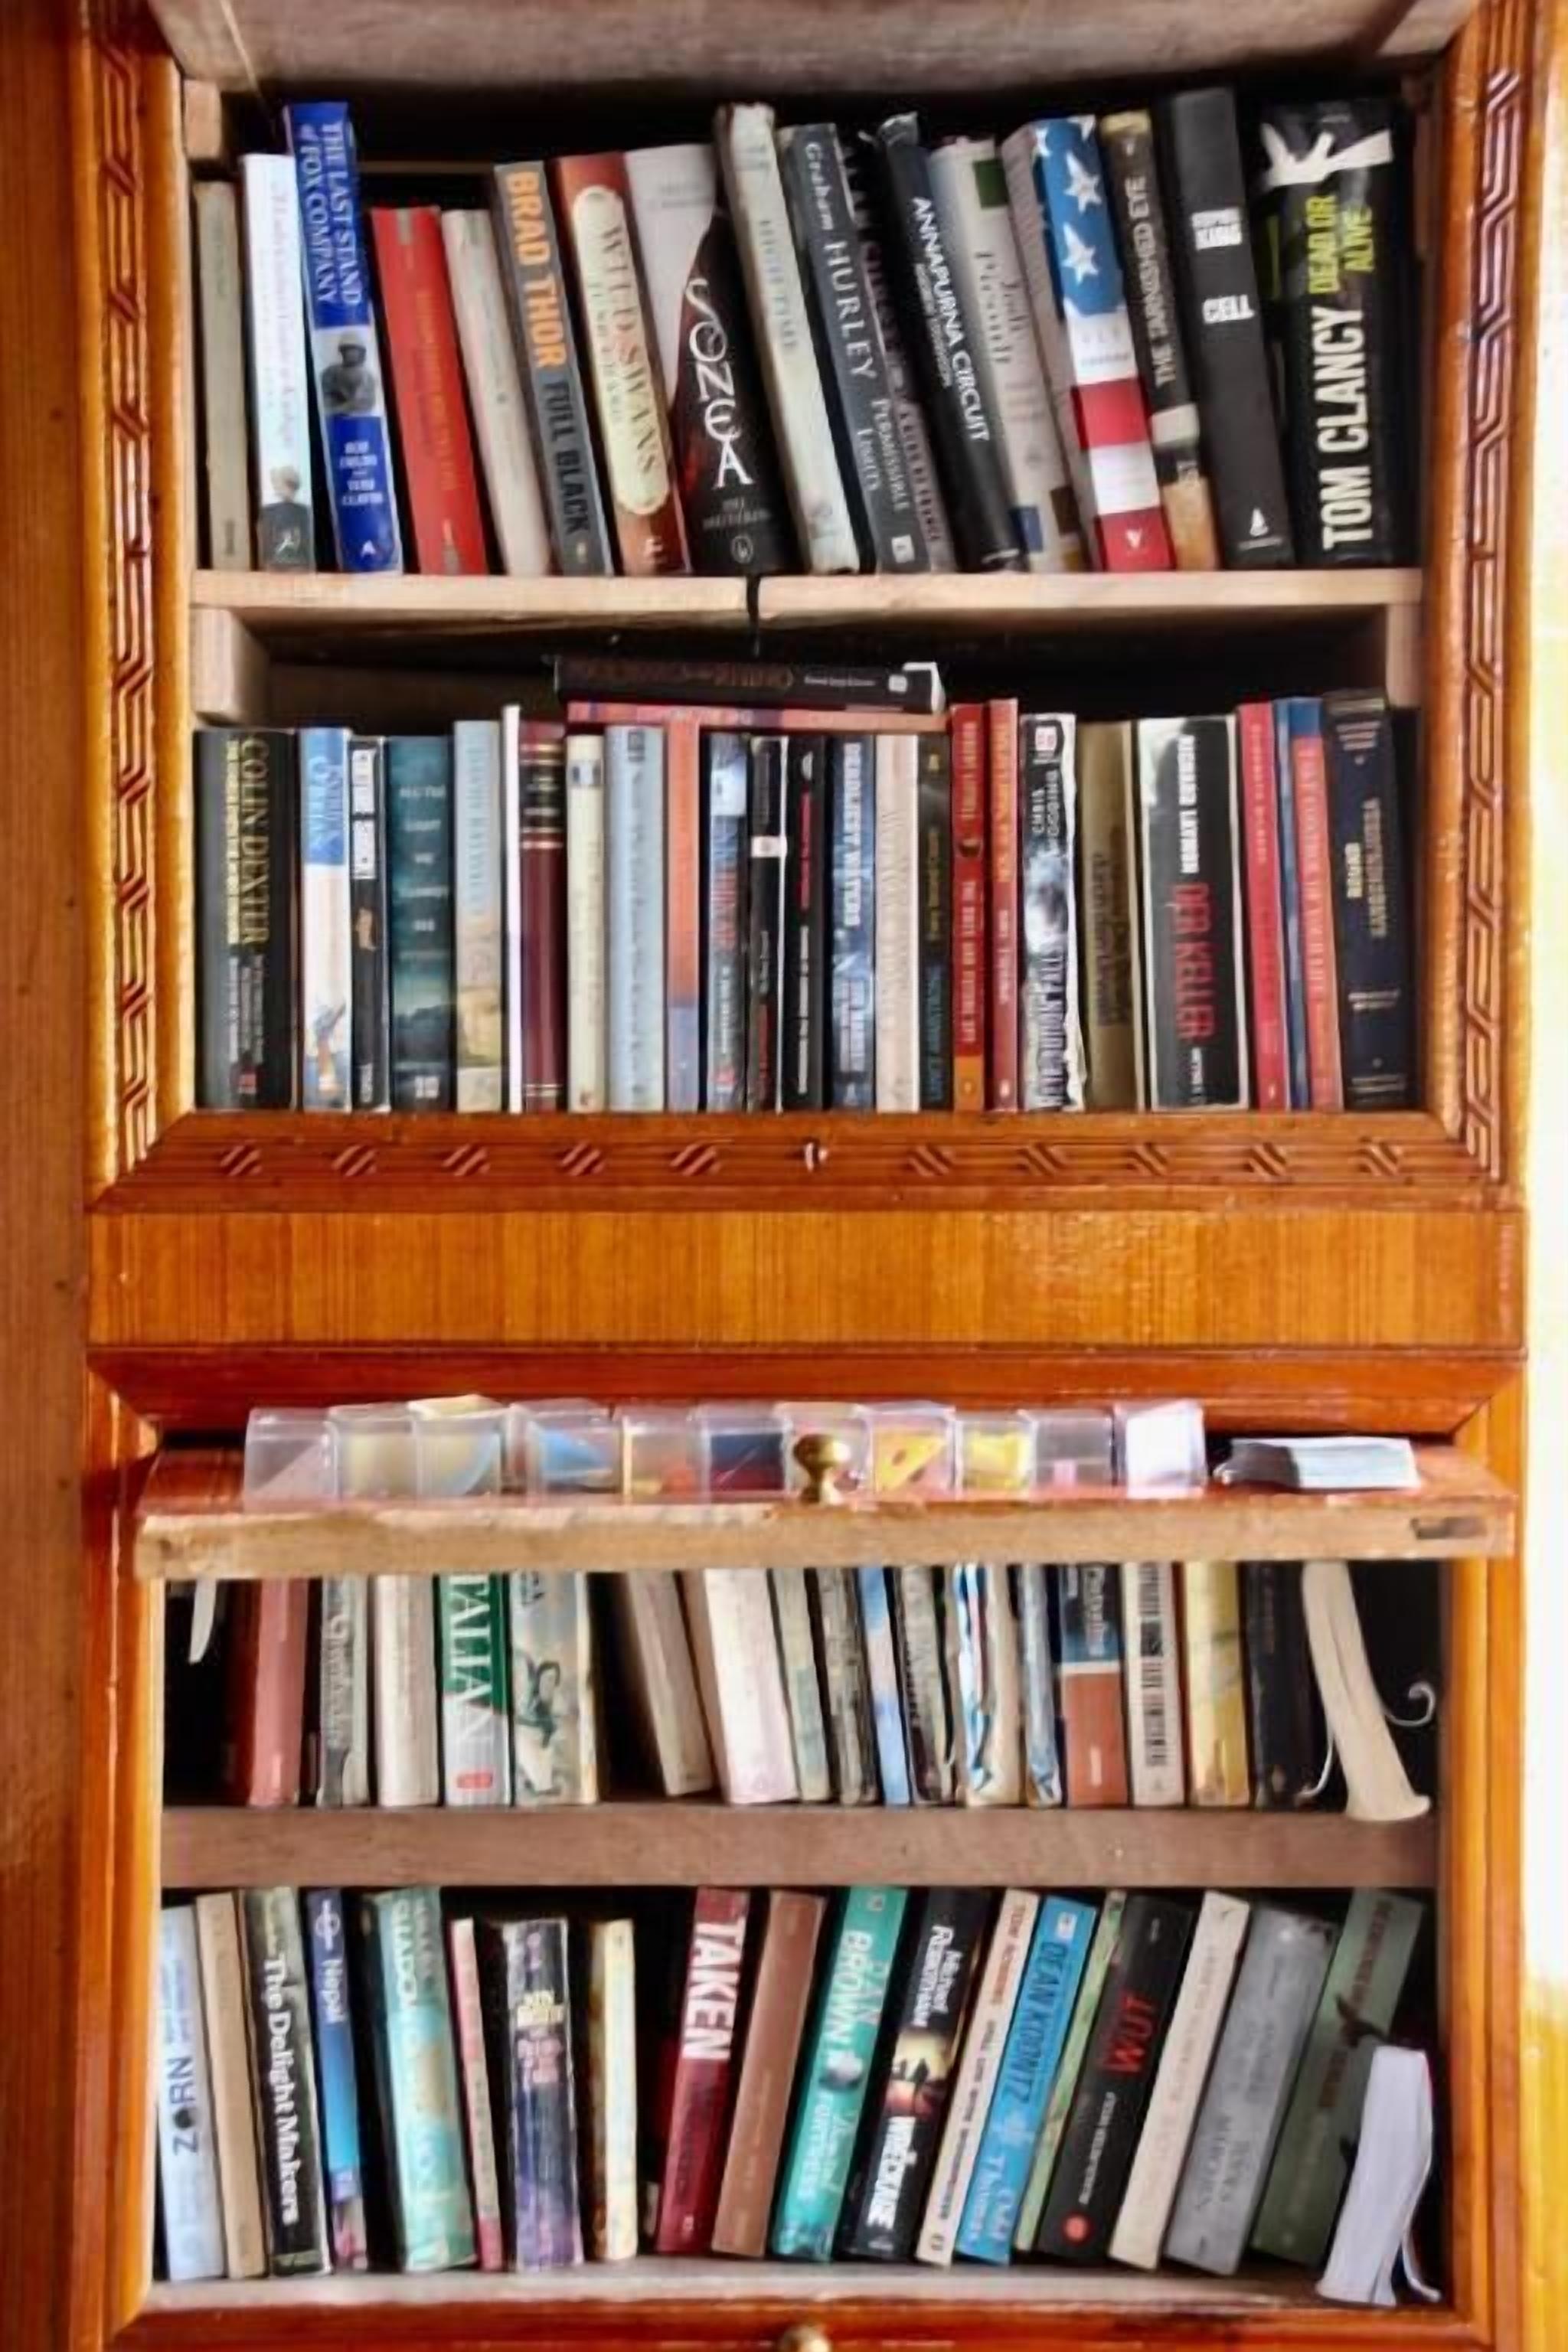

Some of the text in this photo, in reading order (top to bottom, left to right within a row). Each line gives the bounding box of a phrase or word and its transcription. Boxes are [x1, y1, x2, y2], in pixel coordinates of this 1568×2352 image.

[300, 145, 325, 191] FOX
[322, 121, 363, 305] THE LAST STAND
[1124, 175, 1148, 220] EYE
[305, 192, 338, 302] COMPANY
[507, 171, 567, 368] BRAD THOR
[603, 227, 636, 332] WILD
[805, 142, 877, 380] Graham HURLEY
[1305, 194, 1341, 295] DEAD OR
[1344, 207, 1376, 273] ALIVE
[911, 197, 960, 348] ANNAPURNA
[952, 349, 991, 442] CIRCUIT
[1147, 345, 1177, 387] THE
[1202, 294, 1255, 325] CELL
[685, 278, 754, 489] SONEA
[1312, 305, 1374, 550] TOM CLANCY
[544, 379, 591, 534] FULL BLACK
[239, 737, 270, 828] COLIN
[240, 835, 270, 946] DEXTER
[1172, 883, 1217, 1041] DER KELLER
[449, 1574, 495, 1742] TALIAN
[321, 1958, 345, 2024] Nepal
[682, 1916, 749, 2061] TAKEN
[821, 1929, 874, 2052] BROWN
[1008, 1941, 1068, 2104] DEAN KOONTZ
[1107, 1994, 1155, 2075] WUT
[264, 1954, 300, 2226] The Delight Makers
[866, 2115, 916, 2231] WRECKAGE
